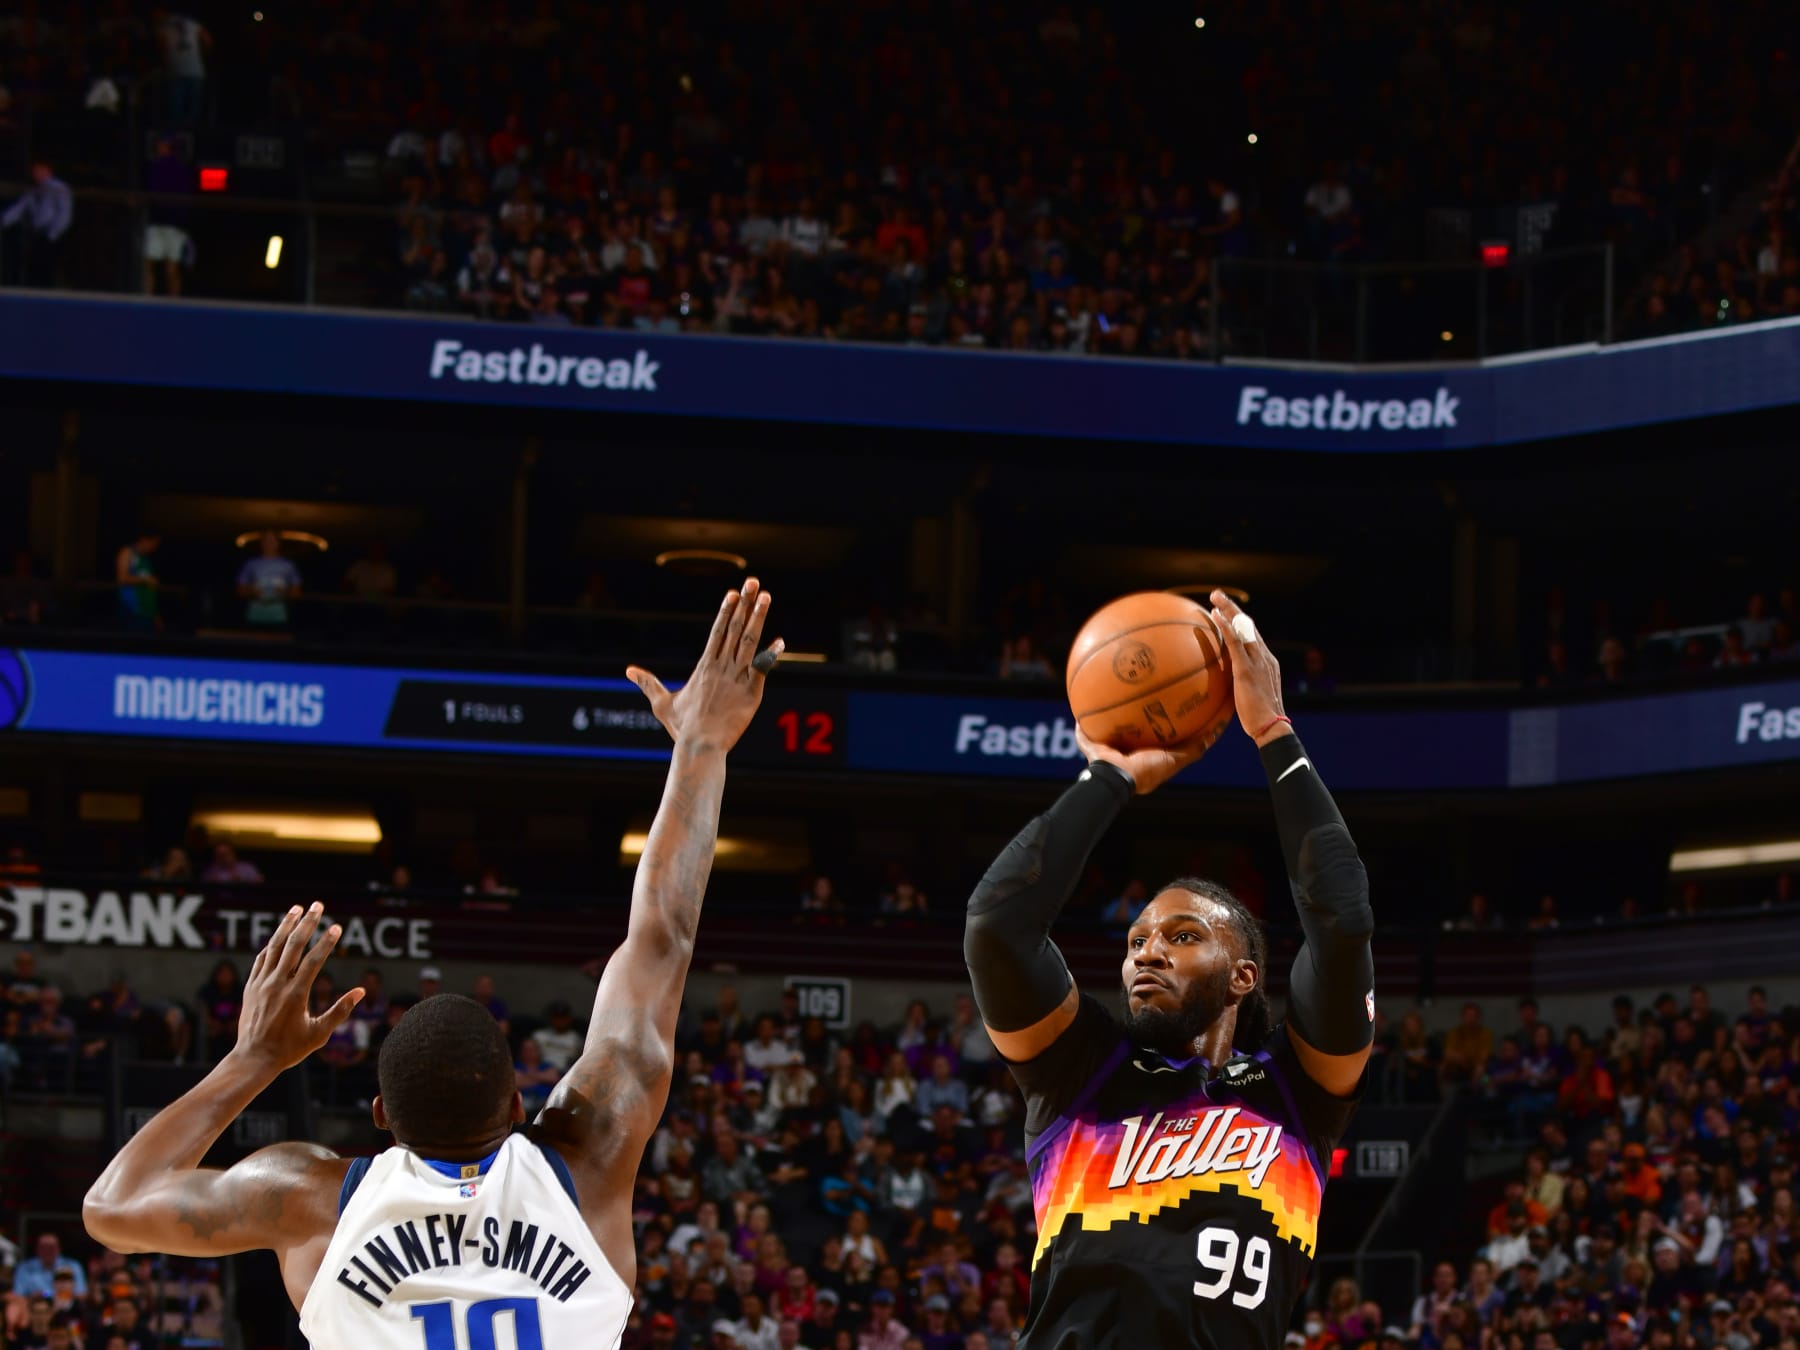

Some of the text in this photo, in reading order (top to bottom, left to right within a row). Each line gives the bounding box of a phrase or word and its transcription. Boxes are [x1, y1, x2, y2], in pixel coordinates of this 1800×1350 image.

[429, 339, 660, 391] Fastbreak
[1237, 386, 1459, 431] Fastbreak
[114, 674, 325, 727] MAVERICKS
[444, 699, 456, 723] 1
[461, 702, 523, 724] FOULS
[572, 706, 589, 731] 6
[777, 710, 833, 754] 12
[955, 714, 1087, 759] Fastb
[799, 987, 840, 1018] 109
[1162, 1117, 1198, 1134] THE
[1108, 1107, 1282, 1190] Valley
[336, 1213, 592, 1309] FINNEY-SMITH
[1193, 1227, 1271, 1310] 99
